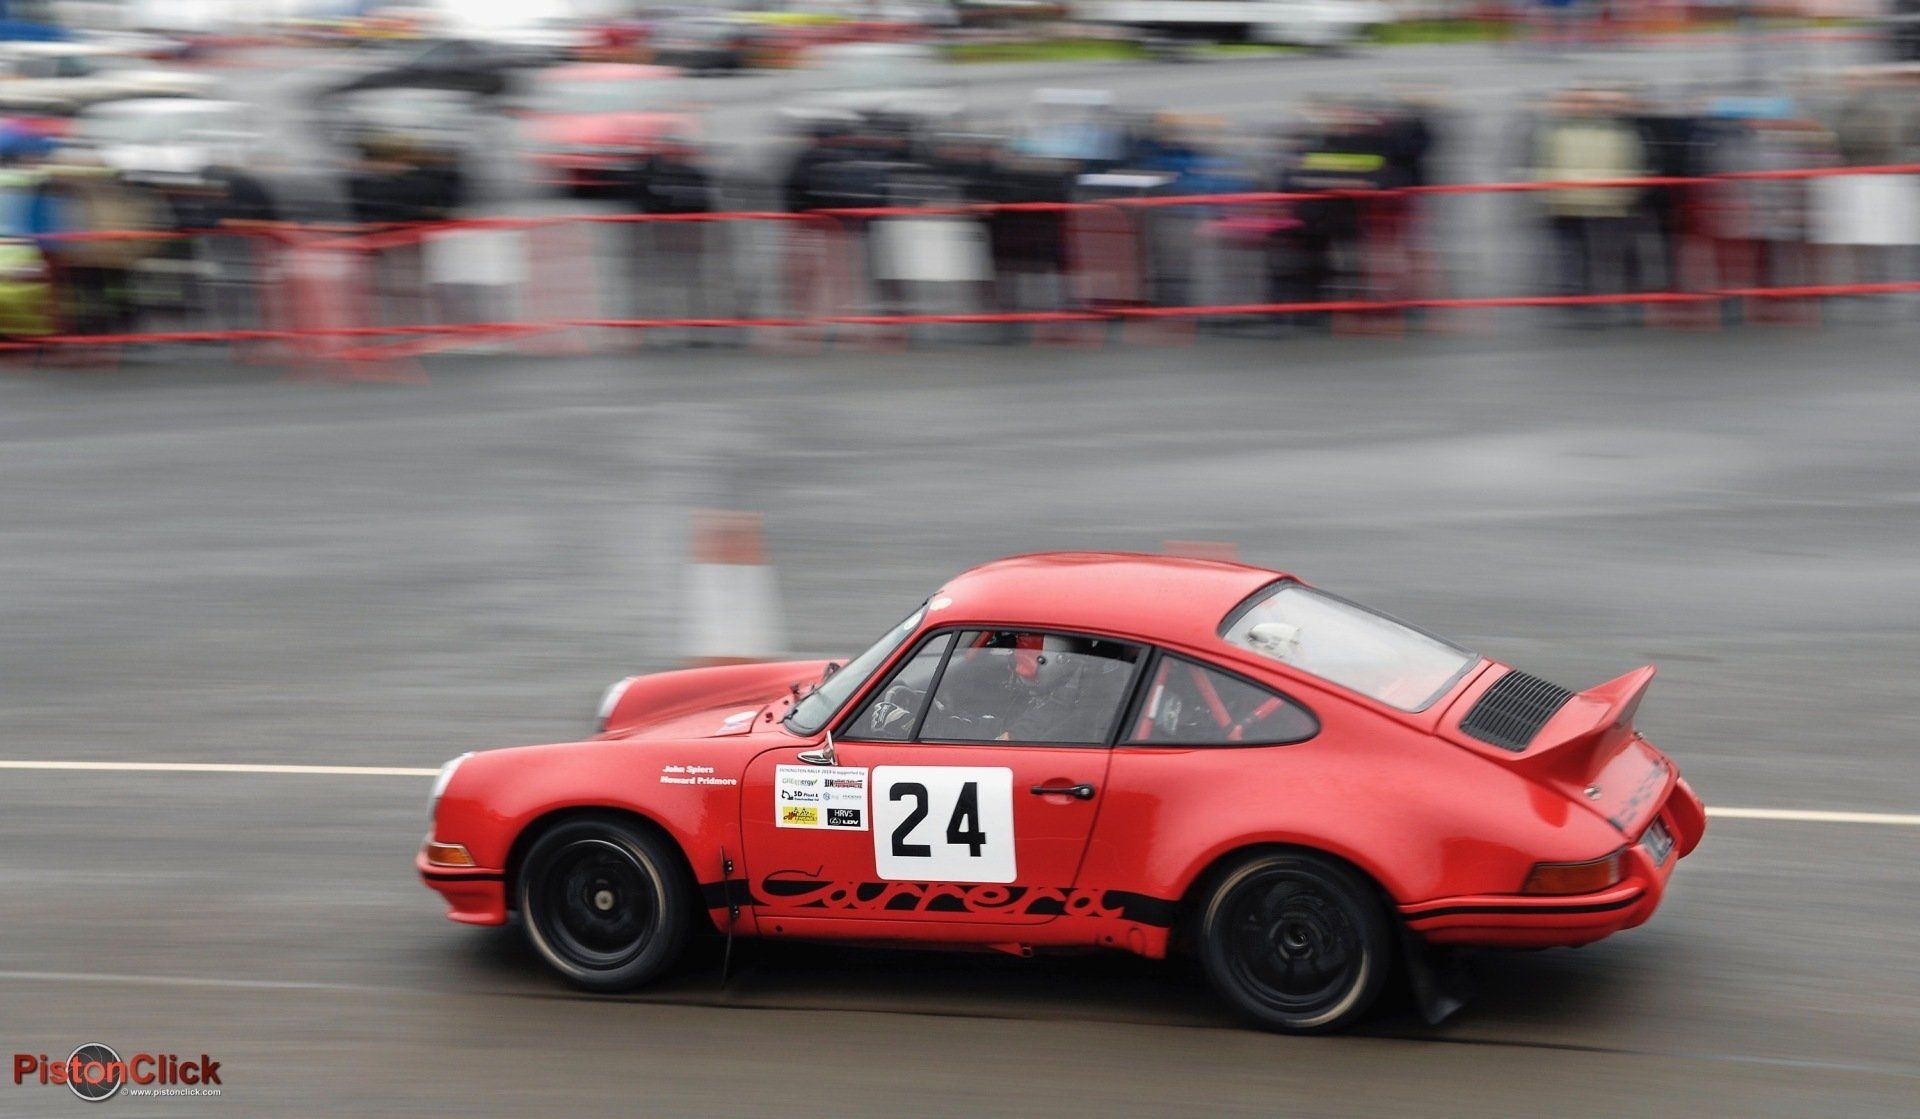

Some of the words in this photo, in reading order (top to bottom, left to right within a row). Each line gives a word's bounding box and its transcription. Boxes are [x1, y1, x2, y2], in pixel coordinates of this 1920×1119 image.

[662, 765, 685, 773] John
[686, 765, 714, 774] Spiers
[660, 775, 696, 784] Howard
[697, 777, 737, 785] Pridmore
[834, 809, 853, 817] HRVS
[889, 781, 986, 857] 24
[749, 865, 1124, 917] Carrera
